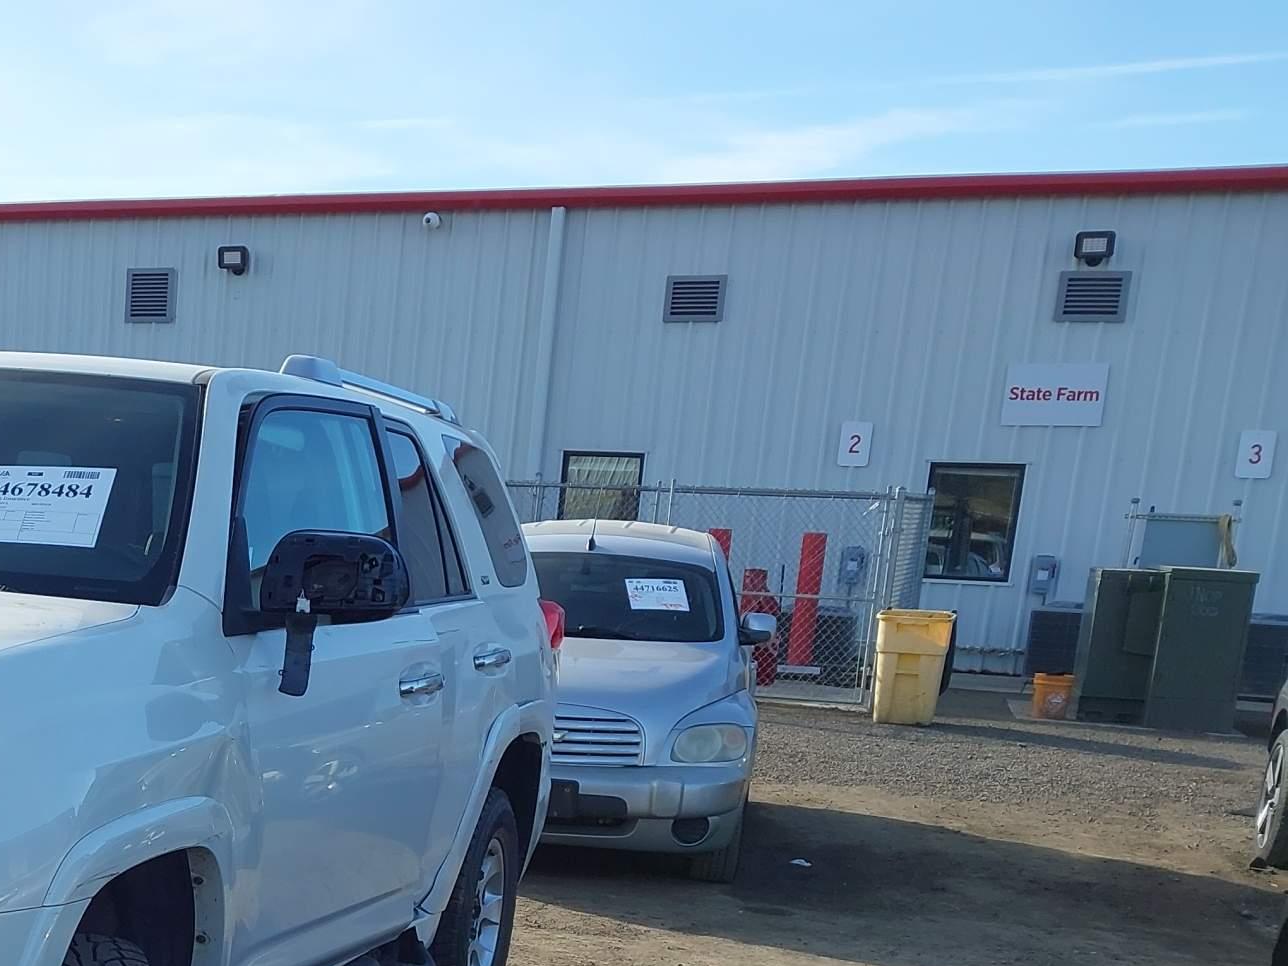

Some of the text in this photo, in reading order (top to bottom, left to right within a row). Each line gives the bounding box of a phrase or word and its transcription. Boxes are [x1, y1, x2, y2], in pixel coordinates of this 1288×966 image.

[1008, 386, 1100, 401] State Farm
[848, 434, 861, 454] 2
[1248, 443, 1263, 465] 3
[633, 584, 679, 593] 44716625
